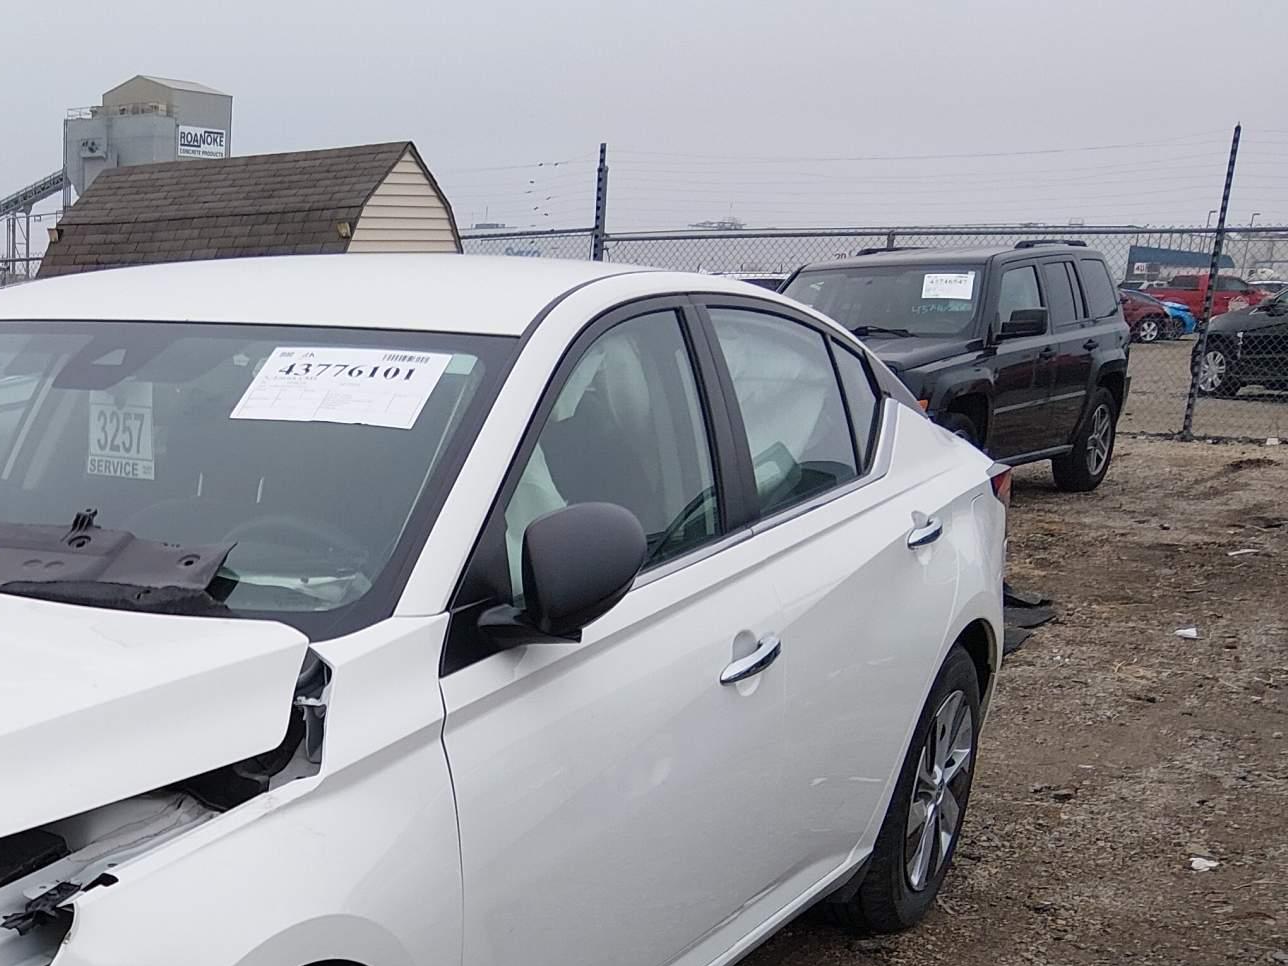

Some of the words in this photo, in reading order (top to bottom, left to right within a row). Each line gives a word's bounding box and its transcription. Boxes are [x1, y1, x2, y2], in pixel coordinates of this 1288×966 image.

[180, 131, 224, 147] ROANOKE
[278, 362, 416, 381] 43776101
[97, 410, 145, 454] 3257
[89, 458, 139, 477] SERVICE
